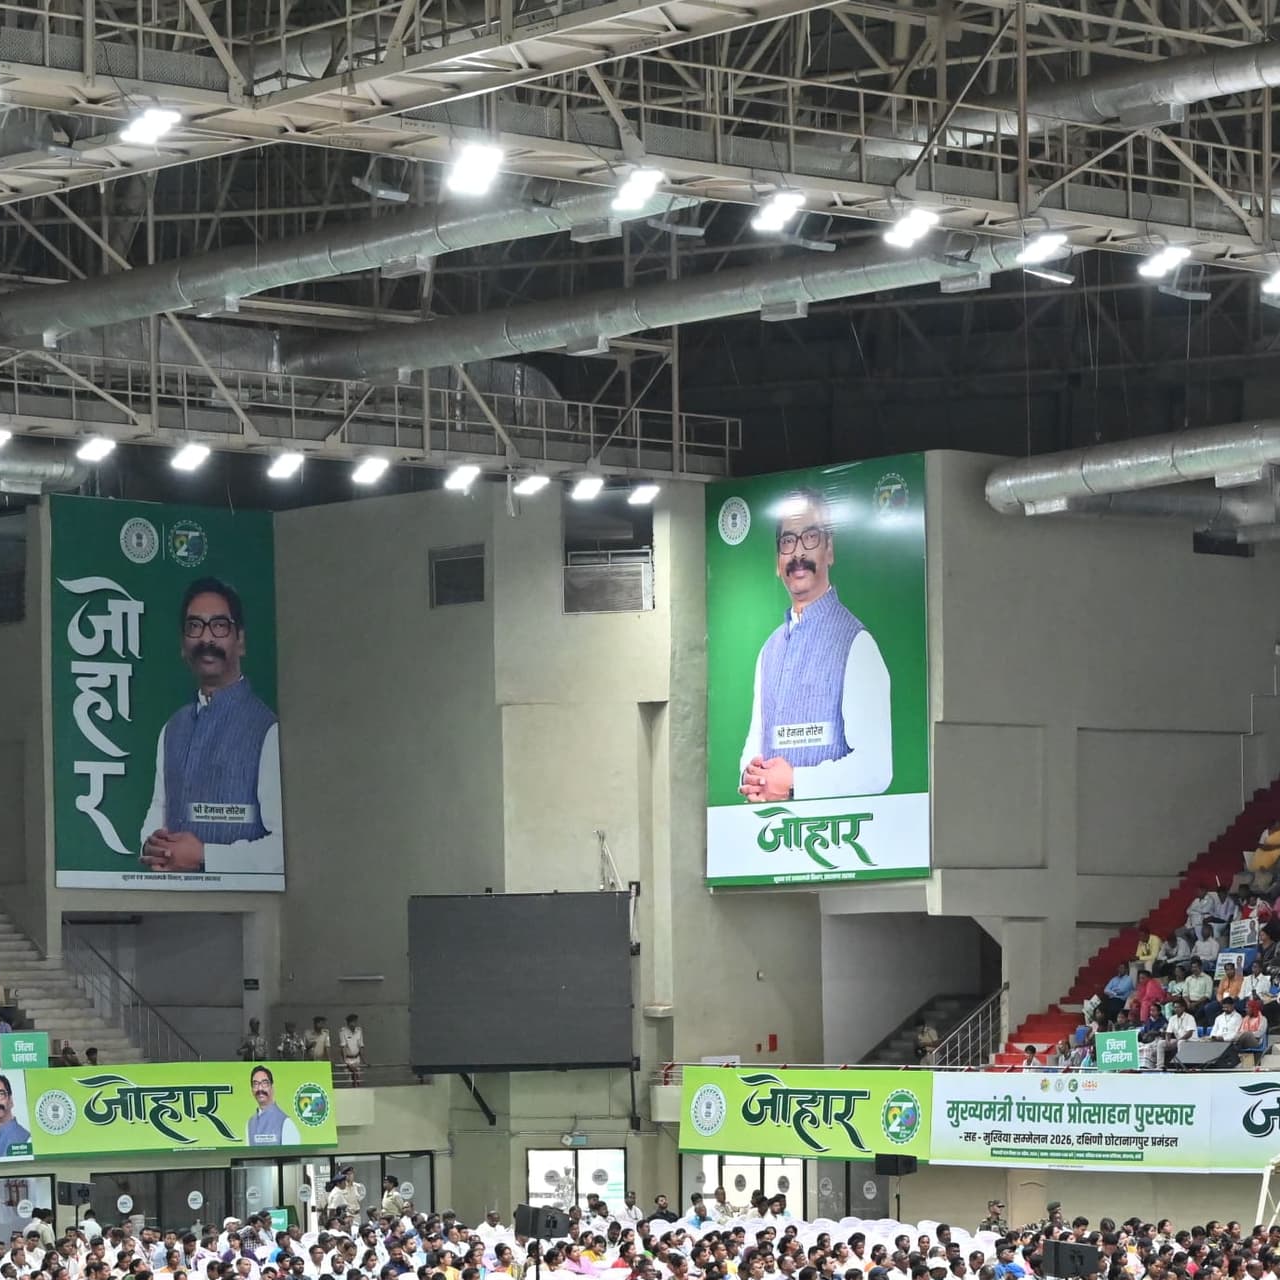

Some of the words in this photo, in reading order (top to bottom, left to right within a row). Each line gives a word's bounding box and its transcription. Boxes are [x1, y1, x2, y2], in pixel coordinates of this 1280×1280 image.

[752, 806, 879, 869] जोहार
[14, 1041, 34, 1052] जिला
[1106, 1039, 1127, 1051] जिला
[73, 1074, 242, 1144] जोहार
[737, 1072, 872, 1152] जोहार
[947, 1096, 1013, 1127] मुख्यमंत्री
[1016, 1097, 1064, 1123] पंचायत
[1067, 1097, 1131, 1125] प्रोत्साहन
[1134, 1103, 1196, 1132] पुरस्कार
[983, 1130, 1011, 1144] मुखिया
[1013, 1134, 1048, 1144] सम्मेलन
[1076, 1135, 1103, 1145] दक्षिणी
[1105, 1136, 1148, 1149] छोटानागपुर
[1151, 1137, 1178, 1148] प्रमंडल
